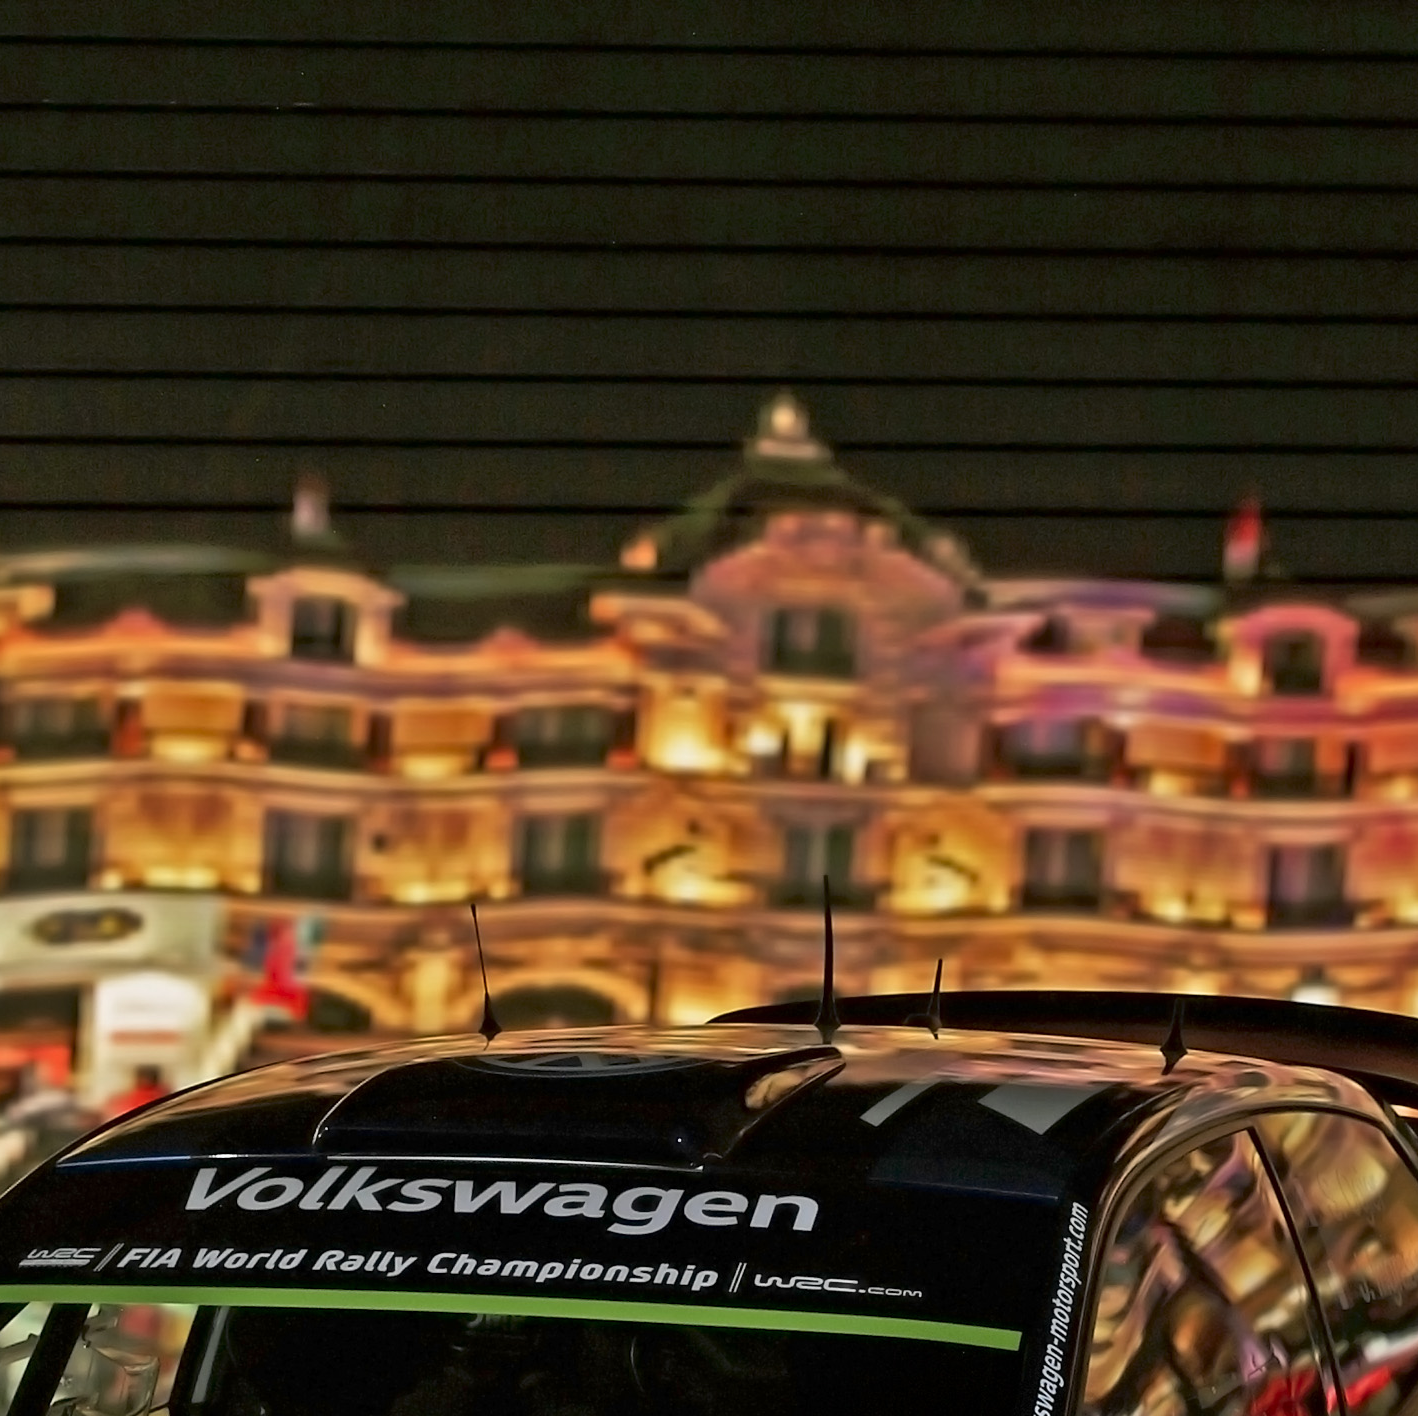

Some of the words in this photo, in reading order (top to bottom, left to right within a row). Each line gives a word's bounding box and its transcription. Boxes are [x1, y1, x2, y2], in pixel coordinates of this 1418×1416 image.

[185, 1166, 819, 1235] Volkswagen
[117, 1247, 182, 1269] FIA
[192, 1247, 308, 1270] World
[312, 1249, 417, 1277] Rally
[426, 1252, 719, 1291] Championship
